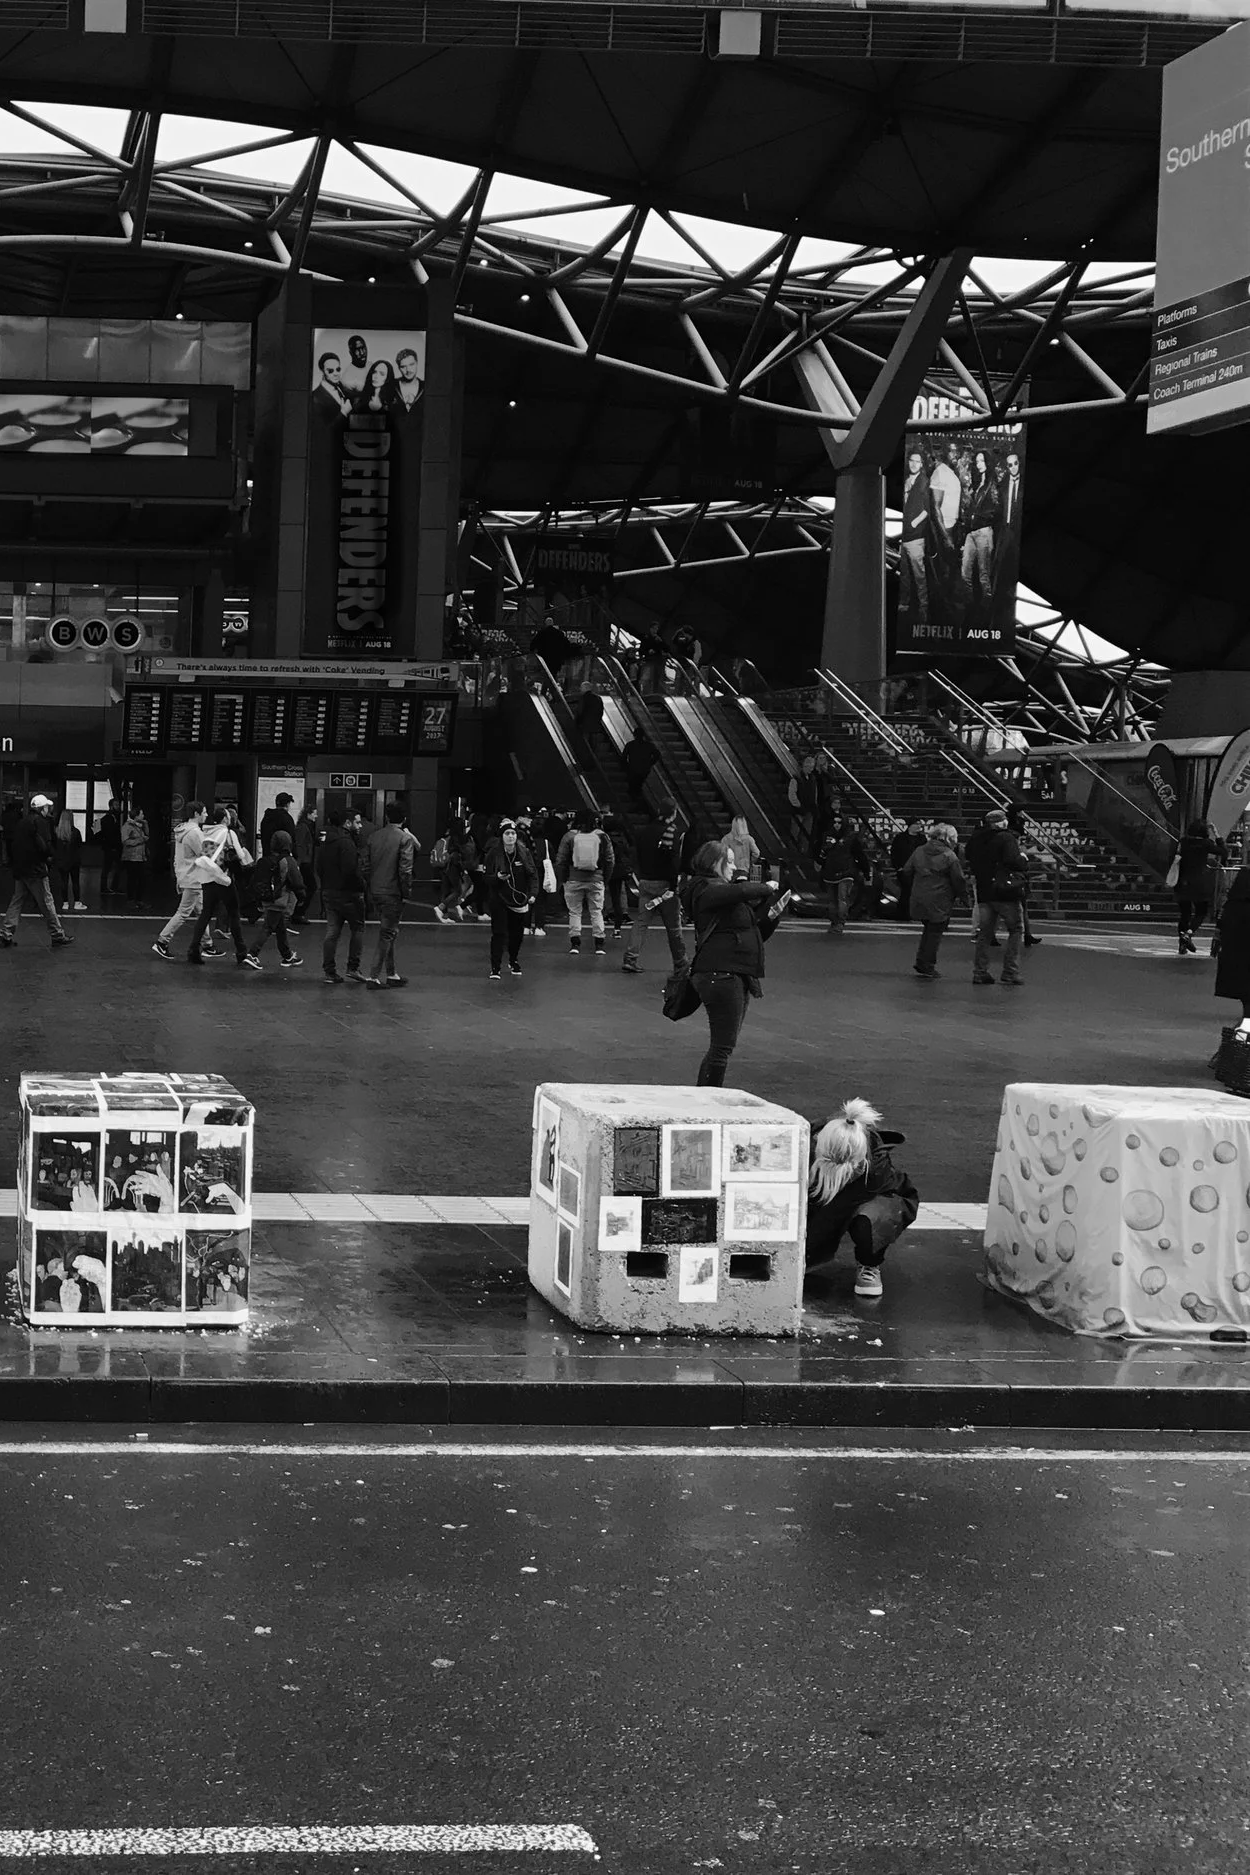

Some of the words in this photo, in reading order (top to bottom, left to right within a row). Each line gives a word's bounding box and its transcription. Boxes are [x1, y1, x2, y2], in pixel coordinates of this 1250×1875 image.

[1166, 118, 1250, 173] Southern
[1157, 305, 1198, 327] Platforms
[1156, 336, 1178, 351] Taxis
[1154, 354, 1191, 376] Regional
[1193, 347, 1219, 363] Trains
[1153, 383, 1181, 400] Coach
[1182, 371, 1217, 391] Terminal
[1218, 364, 1244, 381] 240m
[336, 431, 391, 632] DEFENDERS
[537, 549, 611, 573] DEFENDERS
[912, 624, 954, 640] NETFLIX
[966, 628, 989, 639] AUG
[990, 629, 1002, 640] 18
[327, 639, 356, 649] NETFLIX
[177, 662, 207, 671] There's
[208, 663, 237, 673] always
[238, 663, 258, 672] time
[259, 664, 269, 672] to
[270, 664, 300, 673] refresh
[302, 665, 321, 673] with
[351, 666, 385, 676] Vending
[424, 706, 447, 725] 27
[1123, 903, 1141, 912] AUG
[1142, 904, 1151, 912] 18
